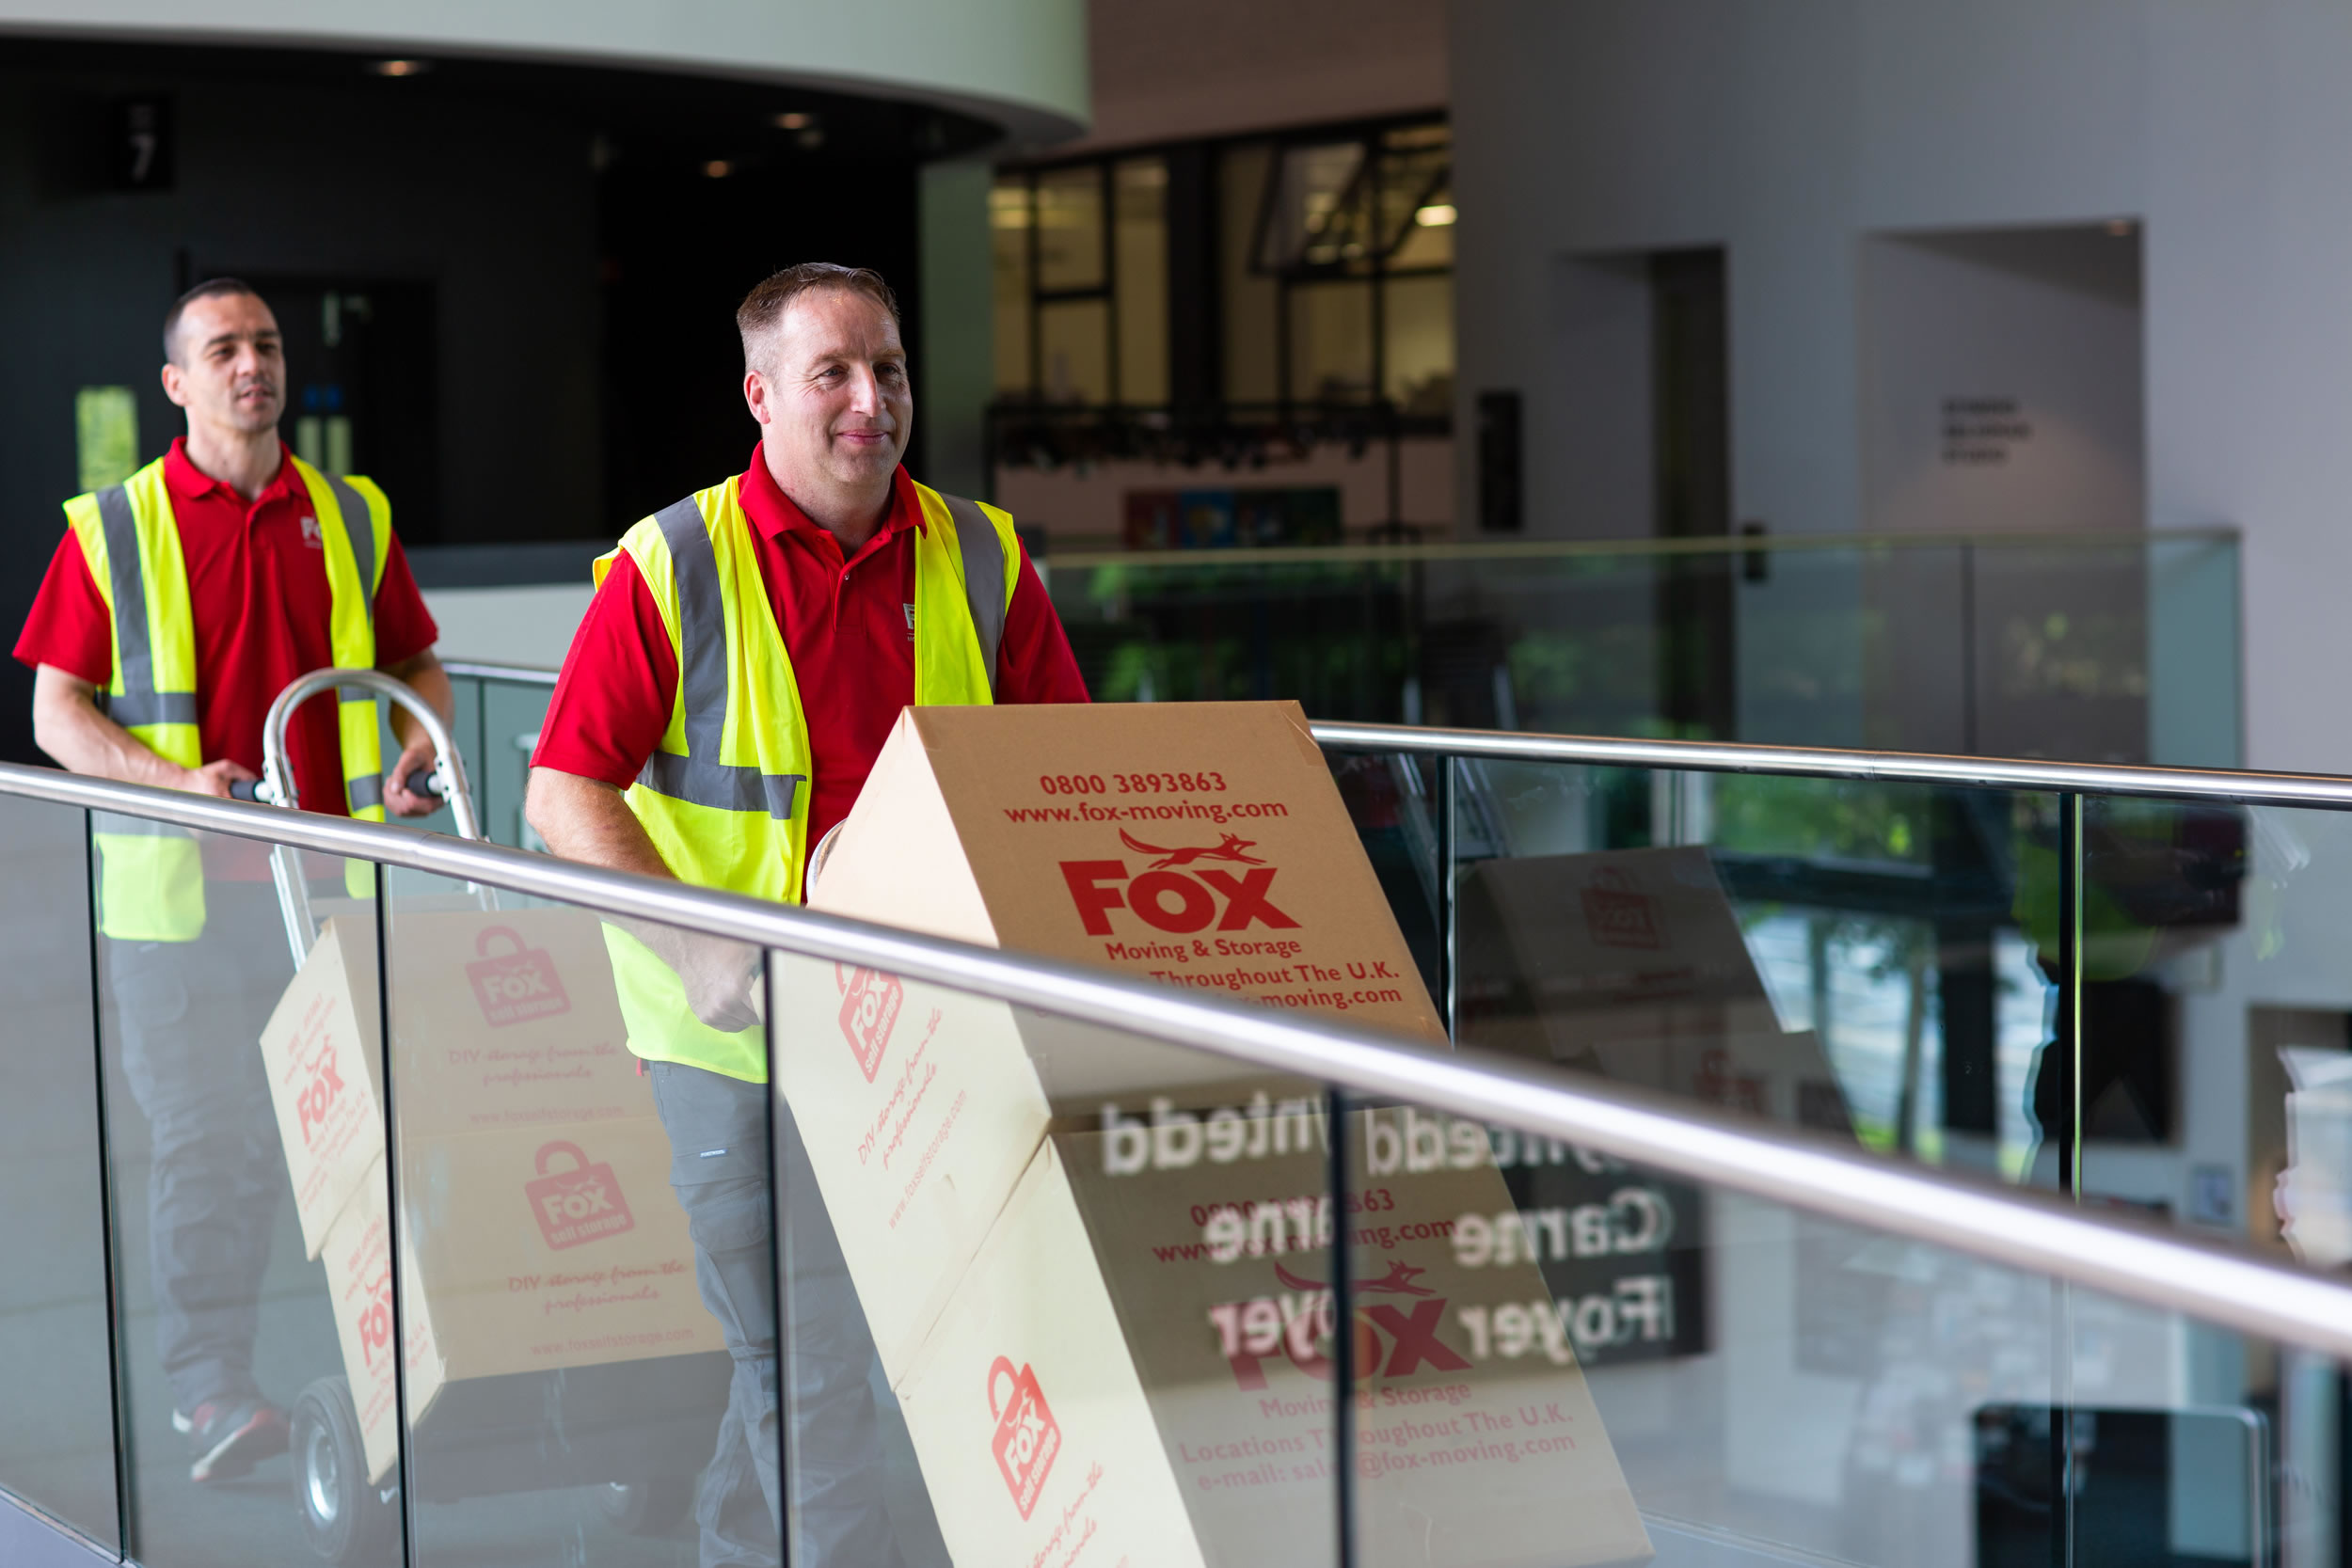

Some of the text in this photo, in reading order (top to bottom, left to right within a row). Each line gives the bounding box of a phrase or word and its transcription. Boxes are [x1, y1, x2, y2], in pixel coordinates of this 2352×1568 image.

[1039, 771, 1227, 796] 0800 3893863
[1003, 800, 1289, 824] www.fox-moving.com
[1058, 859, 1302, 937] FOX
[1104, 938, 1302, 963] Moving & Storage
[482, 969, 550, 1005] FOX
[1149, 960, 1400, 991] Throughout The U.K.
[850, 969, 888, 1052] FOX
[297, 1044, 345, 1147] FOX
[858, 1124, 876, 1165] DIY
[542, 1186, 614, 1225] FOX
[508, 1275, 542, 1292] DIY
[1259, 1393, 1336, 1419] Movin
[1380, 1384, 1471, 1407] Storage
[1004, 1398, 1046, 1486] FOX
[1179, 1402, 1575, 1464] Locations Toughout The U.K.
[1293, 1434, 1577, 1481] sal@fox-moving.com
